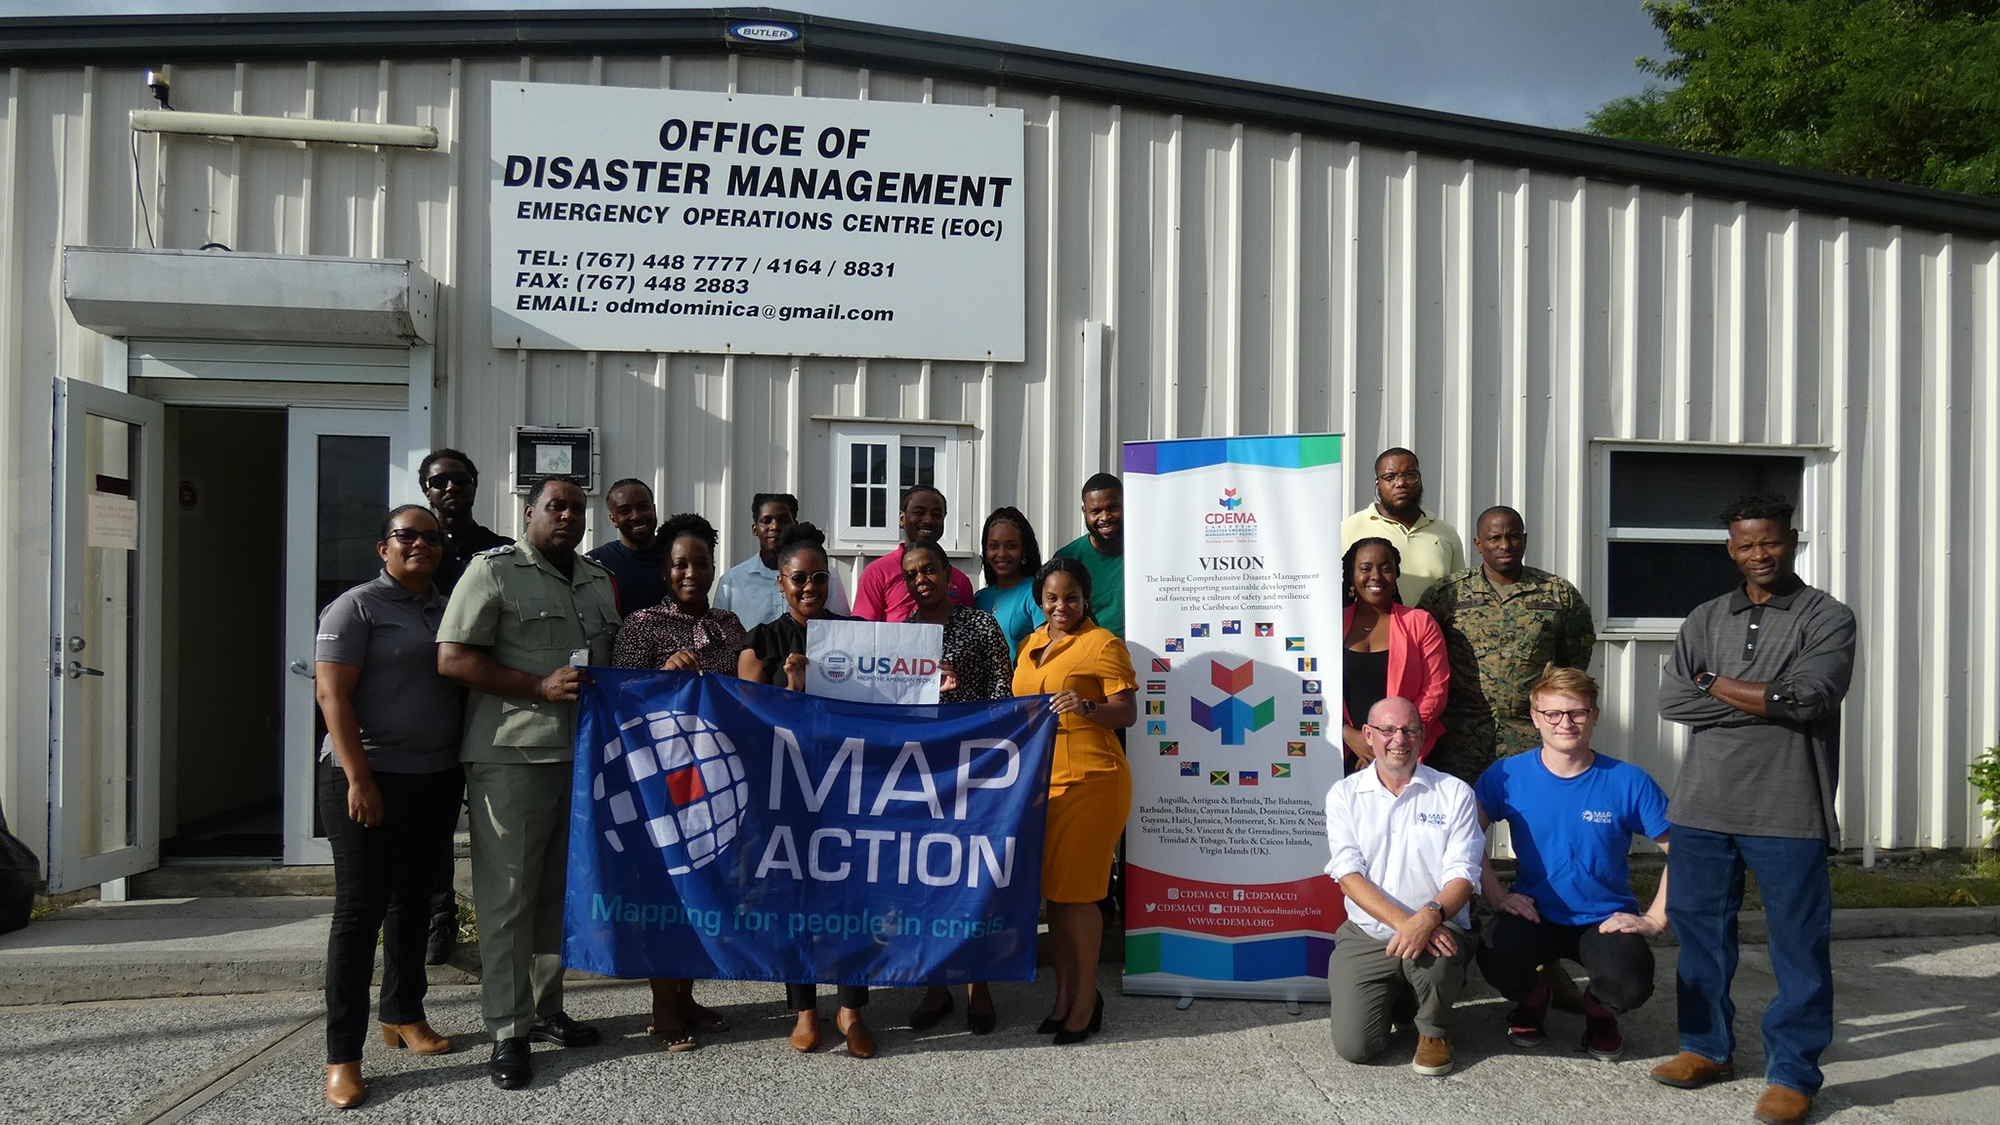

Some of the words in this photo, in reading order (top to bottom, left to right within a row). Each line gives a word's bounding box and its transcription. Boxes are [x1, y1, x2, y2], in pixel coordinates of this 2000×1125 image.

[743, 29, 787, 37] BUTLER
[659, 119, 805, 157] OFFICE
[817, 126, 870, 160] OF
[503, 154, 711, 195] DISASTER
[727, 165, 1012, 208] MANAGEMENT
[517, 202, 670, 225] EMERGENCY
[683, 208, 833, 231] OPERATIONS
[843, 214, 934, 235] CENTRE
[942, 217, 1003, 241] (EOC)
[517, 249, 569, 268] TEL:
[575, 252, 636, 271] (767)
[642, 255, 685, 271] 448
[693, 256, 748, 273] 7777
[752, 257, 762, 275] /
[767, 258, 822, 276] 4164
[828, 259, 837, 277] /
[844, 260, 895, 278] 8831
[516, 273, 570, 290] FAX:
[575, 275, 636, 294] (767)
[643, 277, 686, 293] 448
[694, 277, 749, 295] 2883
[516, 295, 599, 313] EMAIL:
[606, 298, 894, 322] odmdominica@gmail.com
[1205, 513, 1257, 524] CDEMA
[1199, 557, 1265, 571] VISION
[1146, 575, 1158, 583] The
[1160, 575, 1185, 584] leading
[1187, 574, 1241, 583] Comprehensive
[1273, 573, 1319, 582] Management
[1159, 584, 1181, 593] expert
[1182, 584, 1220, 593] supporting
[1261, 583, 1306, 592] development
[1155, 594, 1168, 602] and
[1170, 594, 1200, 602] fostering
[1233, 593, 1241, 601] of
[1242, 593, 1262, 602] safety
[1263, 593, 1277, 601] and
[1188, 603, 1201, 611] the
[1202, 603, 1239, 611] Caribbean
[1240, 603, 1284, 612] Community.
[859, 657, 937, 676] USAID
[768, 726, 1021, 822] MAP
[1158, 797, 1190, 805] Anguilla,
[1191, 797, 1220, 806] Antigua
[1230, 798, 1262, 806] Barbuda,
[1278, 798, 1312, 807] Bahamas,
[1139, 807, 1174, 815] Barbados,
[1176, 807, 1199, 815] Belize,
[1200, 807, 1230, 816] Cayman
[1231, 807, 1258, 816] Islands,
[1260, 808, 1297, 816] Dominica,
[1141, 817, 1170, 825] Guyana,
[1172, 817, 1191, 825] Haiti,
[1193, 817, 1223, 826] Jamaica,
[1224, 817, 1266, 826] Montserrat,
[1298, 818, 1306, 826] &
[1197, 827, 1225, 835] Vincent
[1235, 827, 1247, 835] the
[1248, 827, 1291, 836] Grenadines,
[1292, 828, 1328, 837] Suriname,
[1158, 836, 1189, 844] Trinidad
[1199, 837, 1227, 845] Tobago,
[1285, 838, 1312, 846] Islands,
[1199, 847, 1223, 855] Virgin
[1224, 847, 1249, 855] Islands
[1251, 848, 1271, 856] (UK).
[755, 826, 1016, 889] ACTION
[1246, 892, 1298, 901] CDEMACU1
[1158, 904, 1204, 913] CDEMACU
[1223, 906, 1322, 916] CDEMACoordinatingUnit
[592, 893, 720, 937] Mapping
[733, 905, 778, 932] for
[788, 910, 894, 941] people
[898, 910, 921, 935] in
[931, 915, 1004, 940] crisis
[1188, 918, 1274, 927] WWW.CDEMA.ORG
